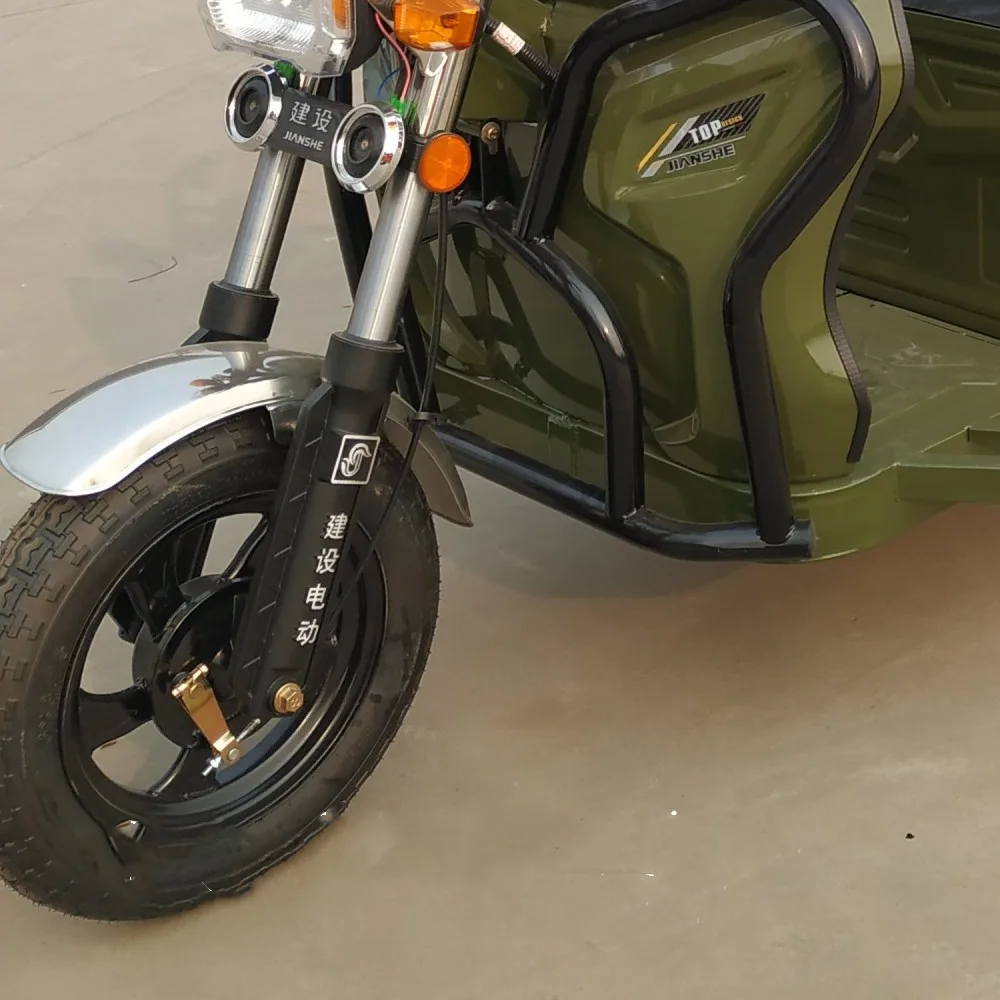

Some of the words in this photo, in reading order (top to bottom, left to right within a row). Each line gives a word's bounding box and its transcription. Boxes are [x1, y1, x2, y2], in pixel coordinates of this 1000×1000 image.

[289, 101, 333, 133] 建设
[687, 119, 722, 144] TOP
[282, 131, 325, 151] JIANSHE
[667, 143, 736, 173] JIANSHE
[296, 513, 348, 646] 建设电动
